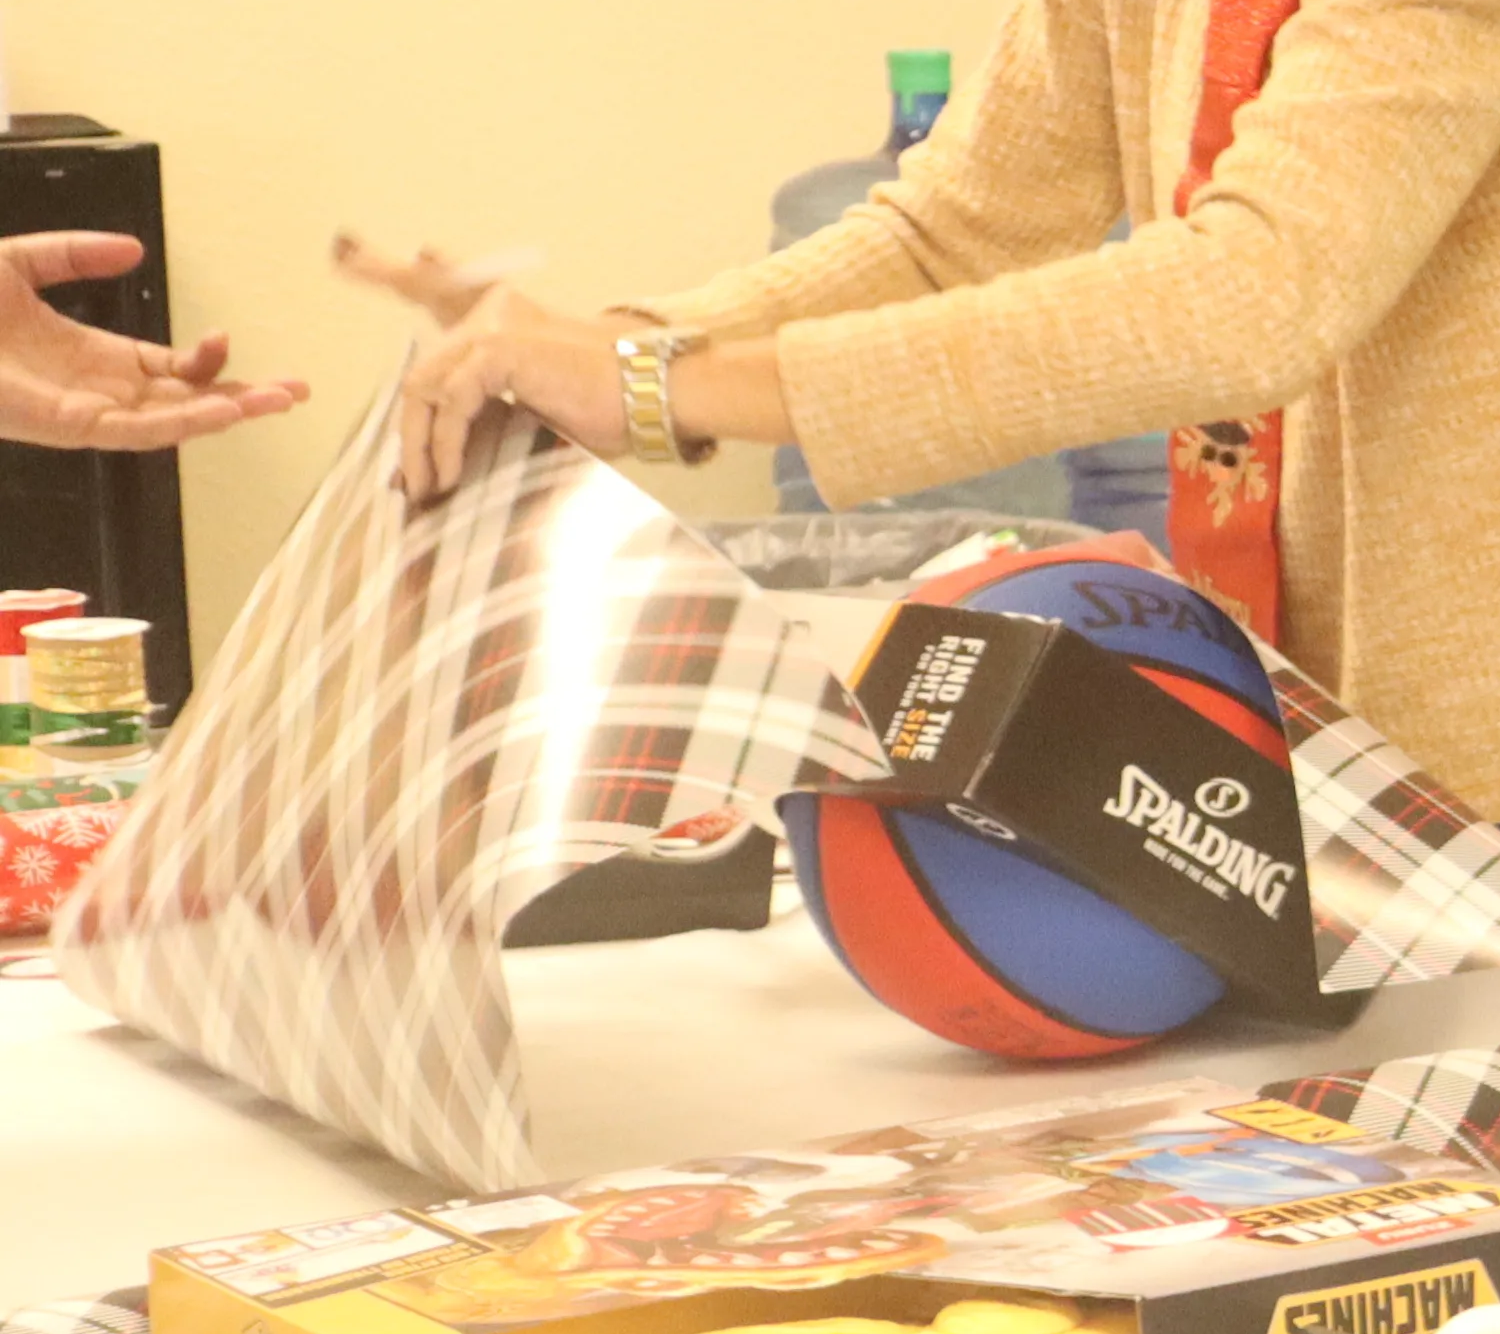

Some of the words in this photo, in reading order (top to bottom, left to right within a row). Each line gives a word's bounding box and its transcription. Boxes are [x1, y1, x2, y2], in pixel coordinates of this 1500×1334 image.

[916, 635, 961, 704] RIGHT
[937, 636, 987, 703] FIND
[890, 708, 928, 759] SIZE
[909, 709, 954, 763] THE
[1102, 763, 1297, 917] SPALDING
[1236, 1181, 1460, 1228] MACHINES
[1257, 1191, 1494, 1244] METAL
